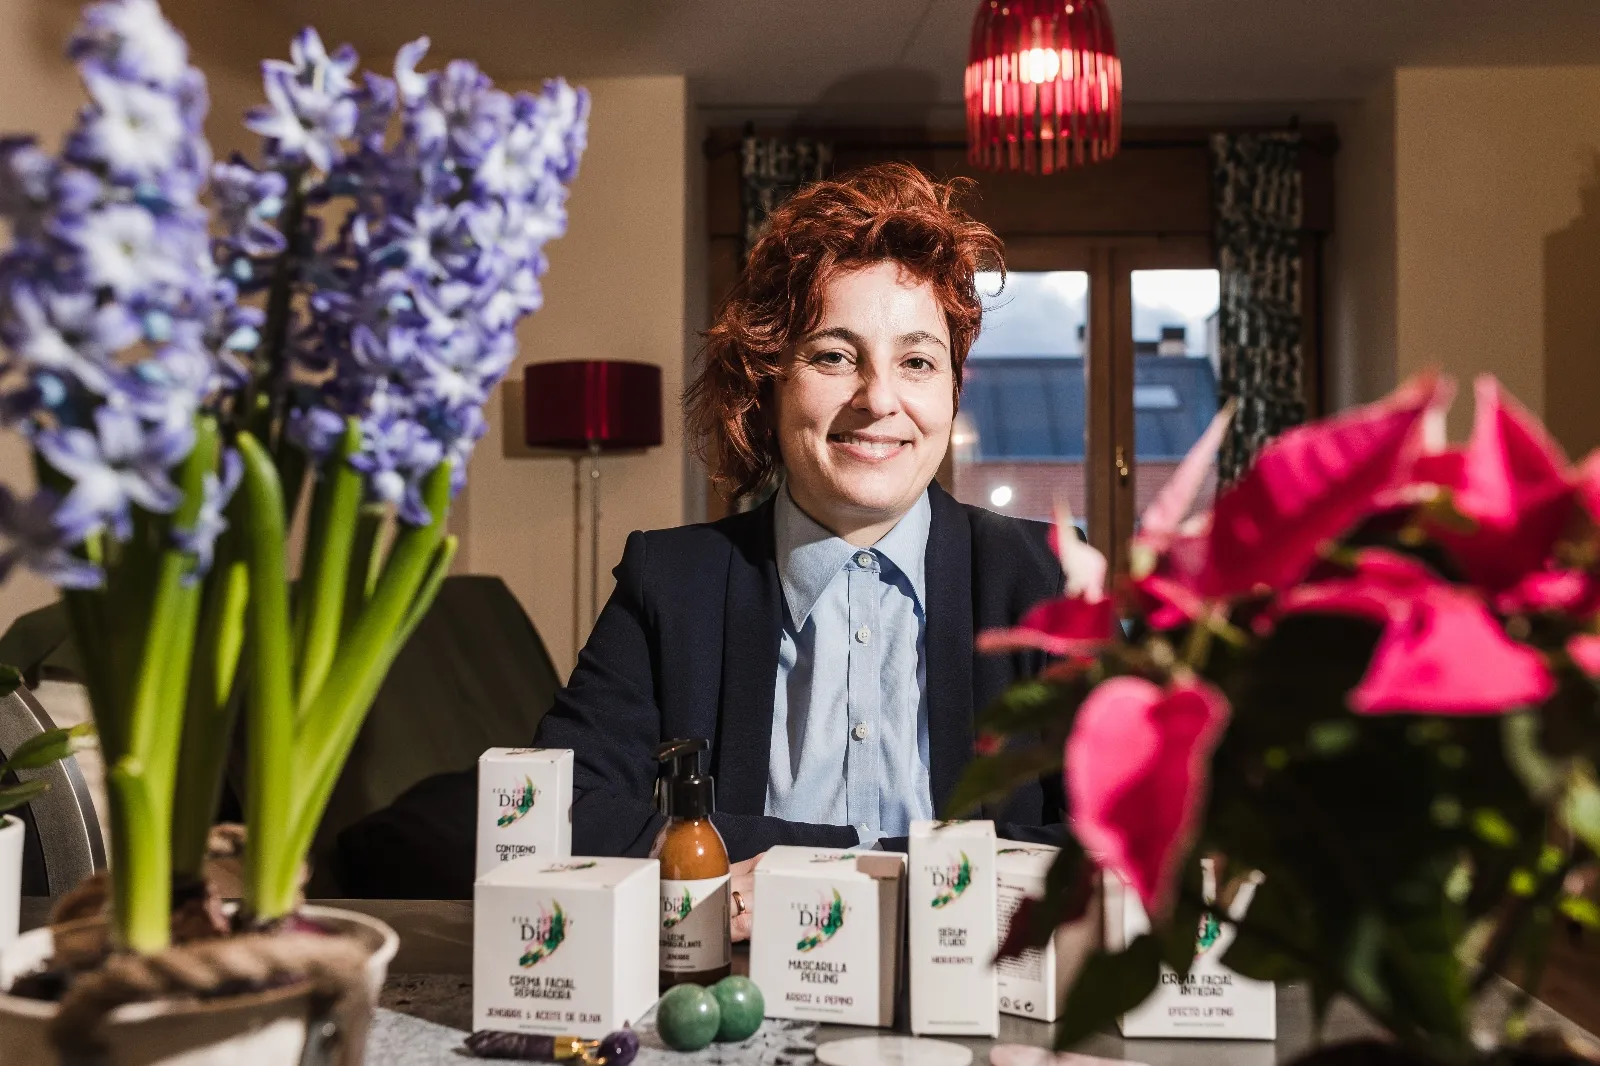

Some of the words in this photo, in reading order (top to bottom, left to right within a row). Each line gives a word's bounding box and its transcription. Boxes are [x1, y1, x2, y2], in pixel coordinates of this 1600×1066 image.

[499, 794, 535, 807] Dido
[495, 844, 536, 854] CONTORNO
[500, 853, 509, 861] DE
[788, 960, 847, 973] MASCARILLA
[509, 975, 541, 987] CREMA
[545, 977, 576, 990] FACIAL
[800, 971, 839, 985] PEELING
